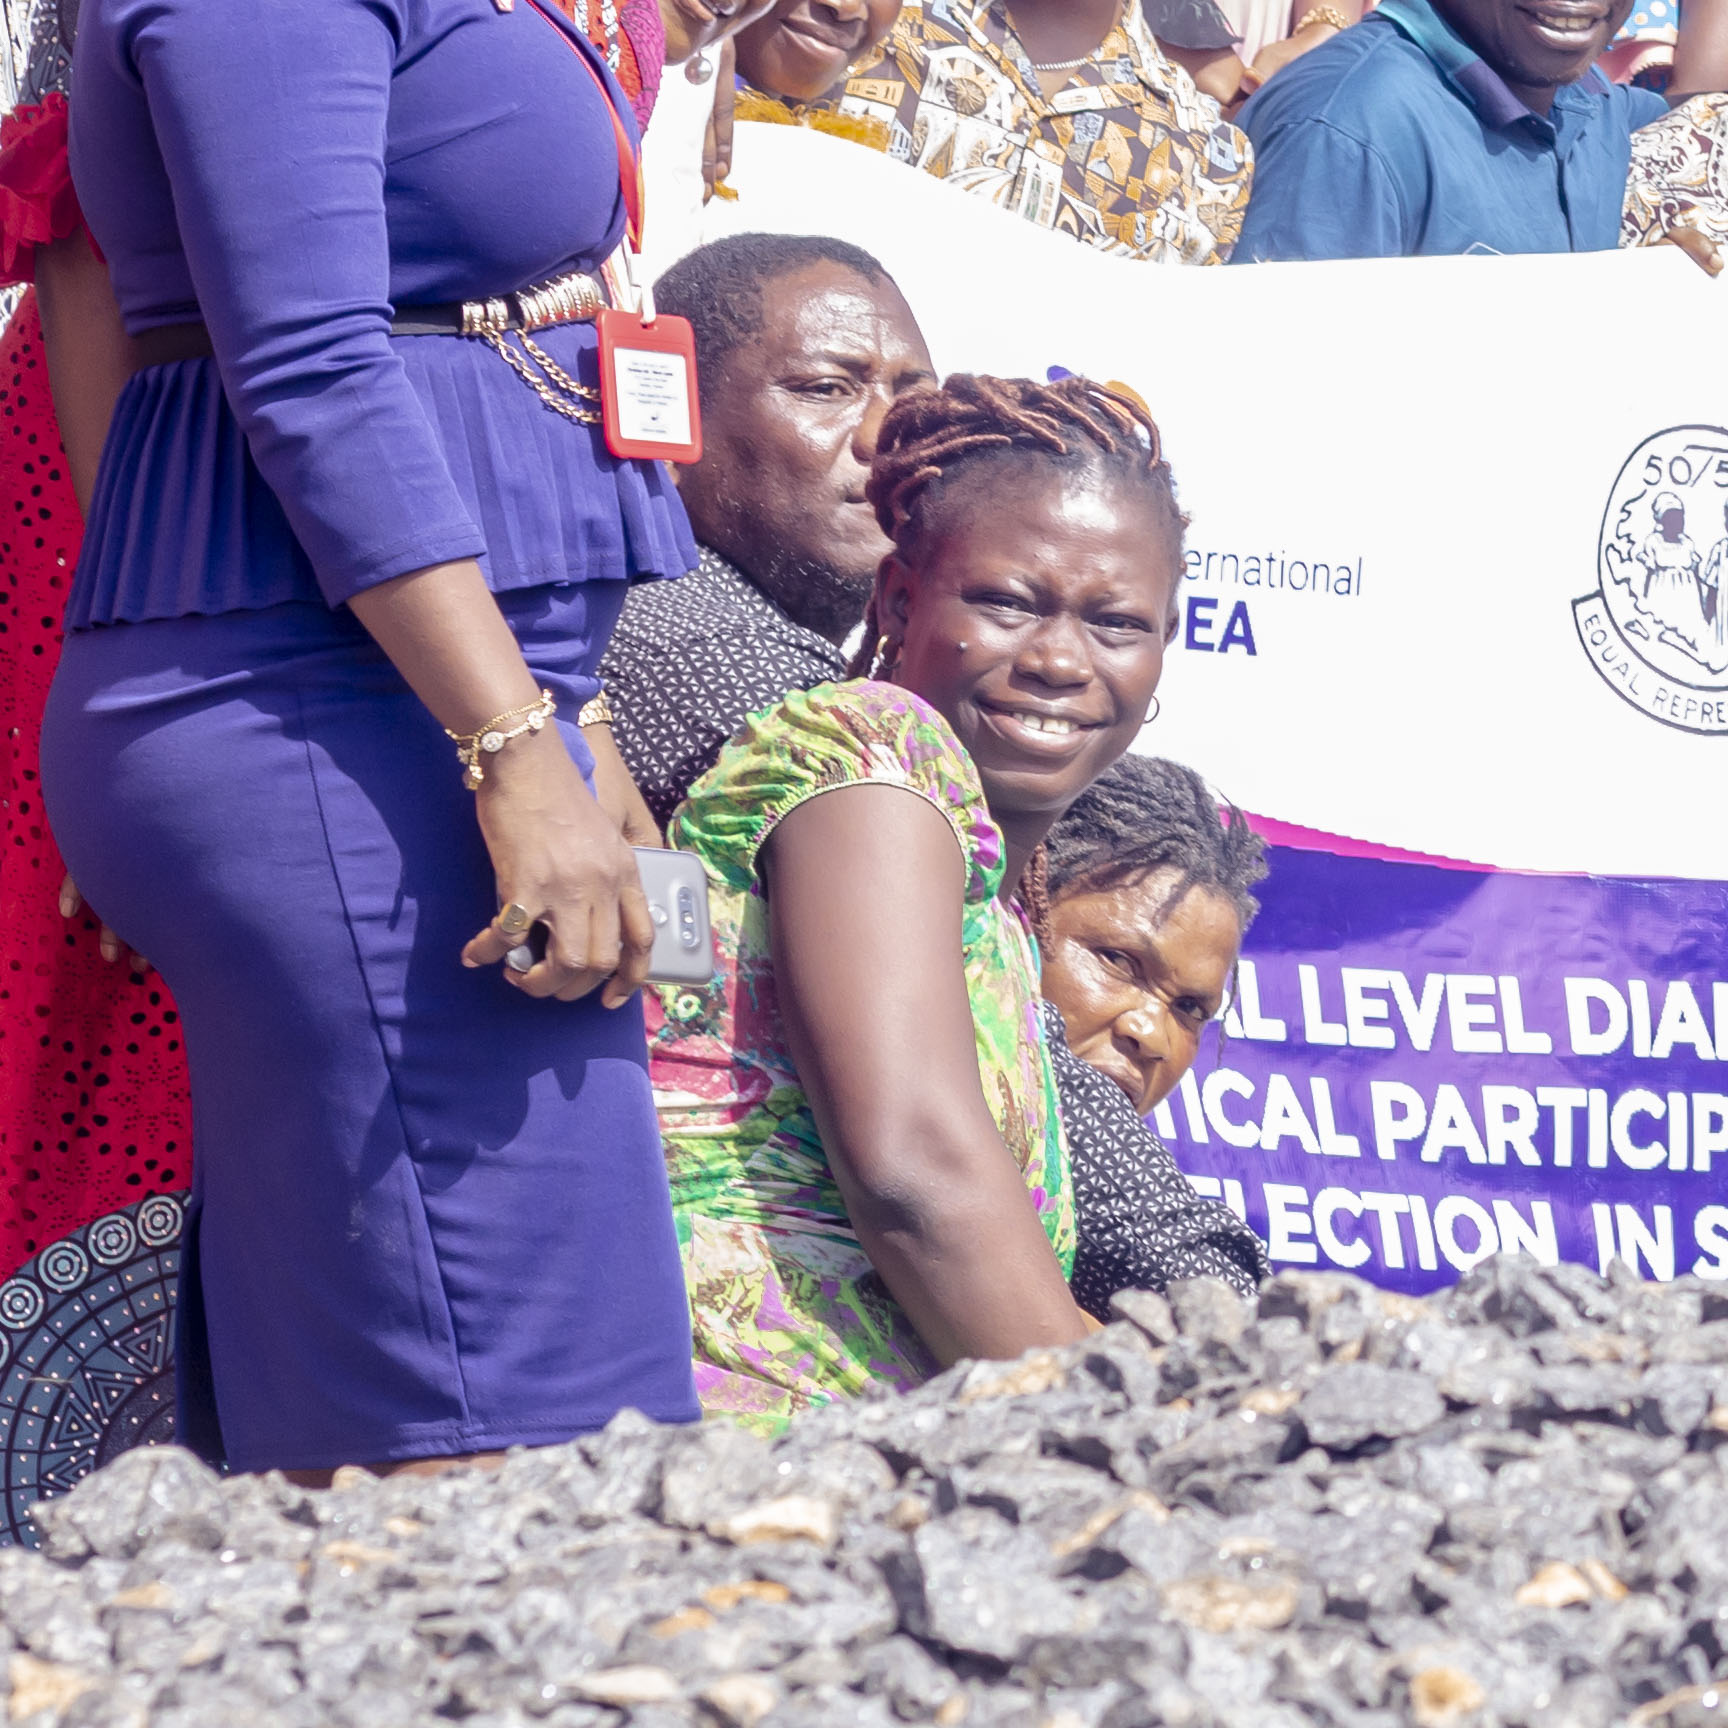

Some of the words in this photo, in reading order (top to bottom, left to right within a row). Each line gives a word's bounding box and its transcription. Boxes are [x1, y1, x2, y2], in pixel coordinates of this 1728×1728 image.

[1584, 613, 1640, 696] EQUAL
[1298, 964, 1553, 1055] LEVEL
[1592, 1201, 1675, 1282] IN
